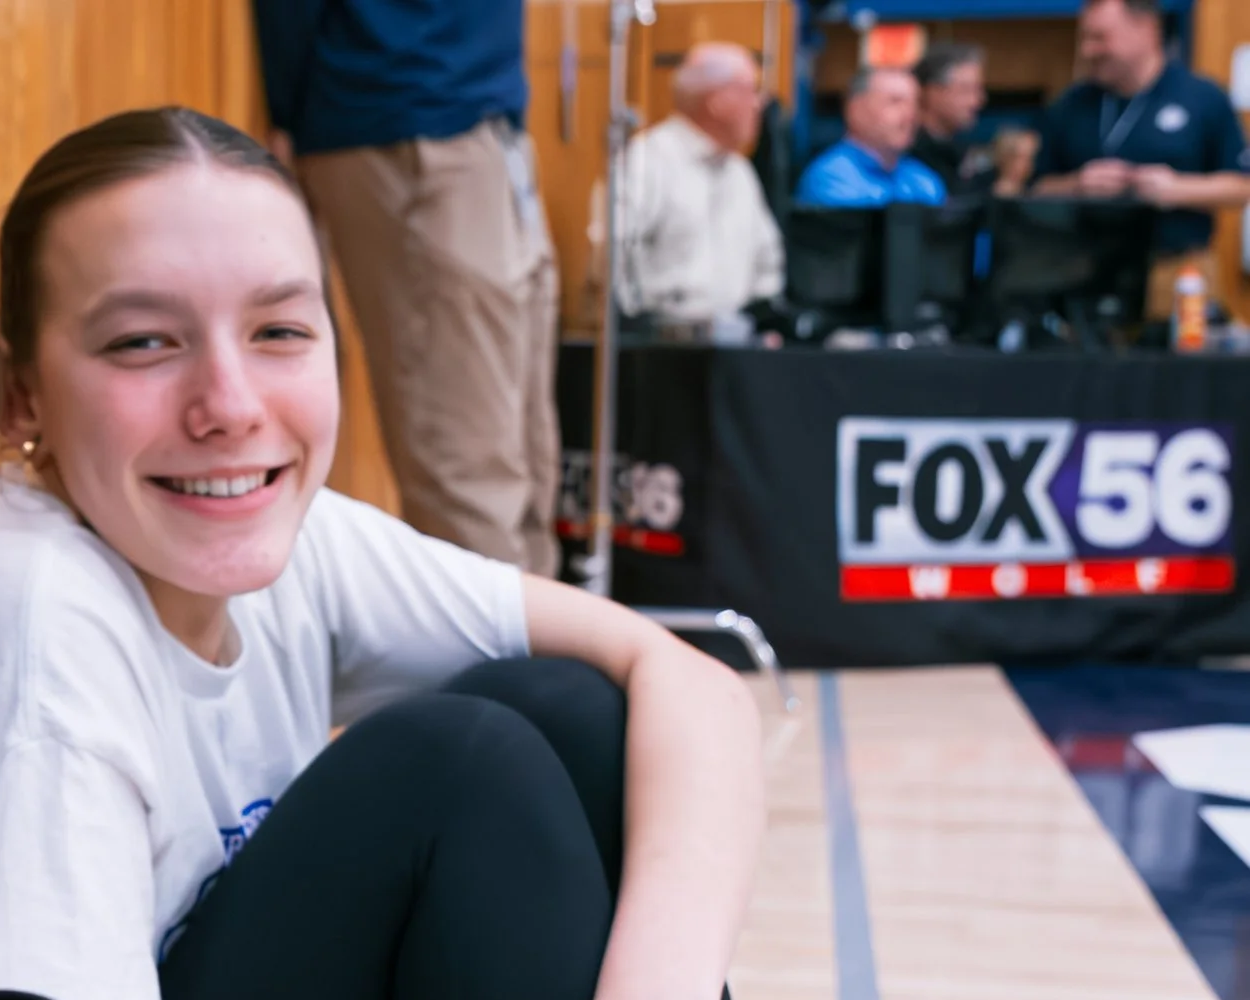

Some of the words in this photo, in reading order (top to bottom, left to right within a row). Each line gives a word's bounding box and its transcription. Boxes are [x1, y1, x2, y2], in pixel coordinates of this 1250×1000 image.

[854, 436, 1050, 545] FOX
[1075, 427, 1232, 548] 56
[908, 557, 1168, 600] WOLF
